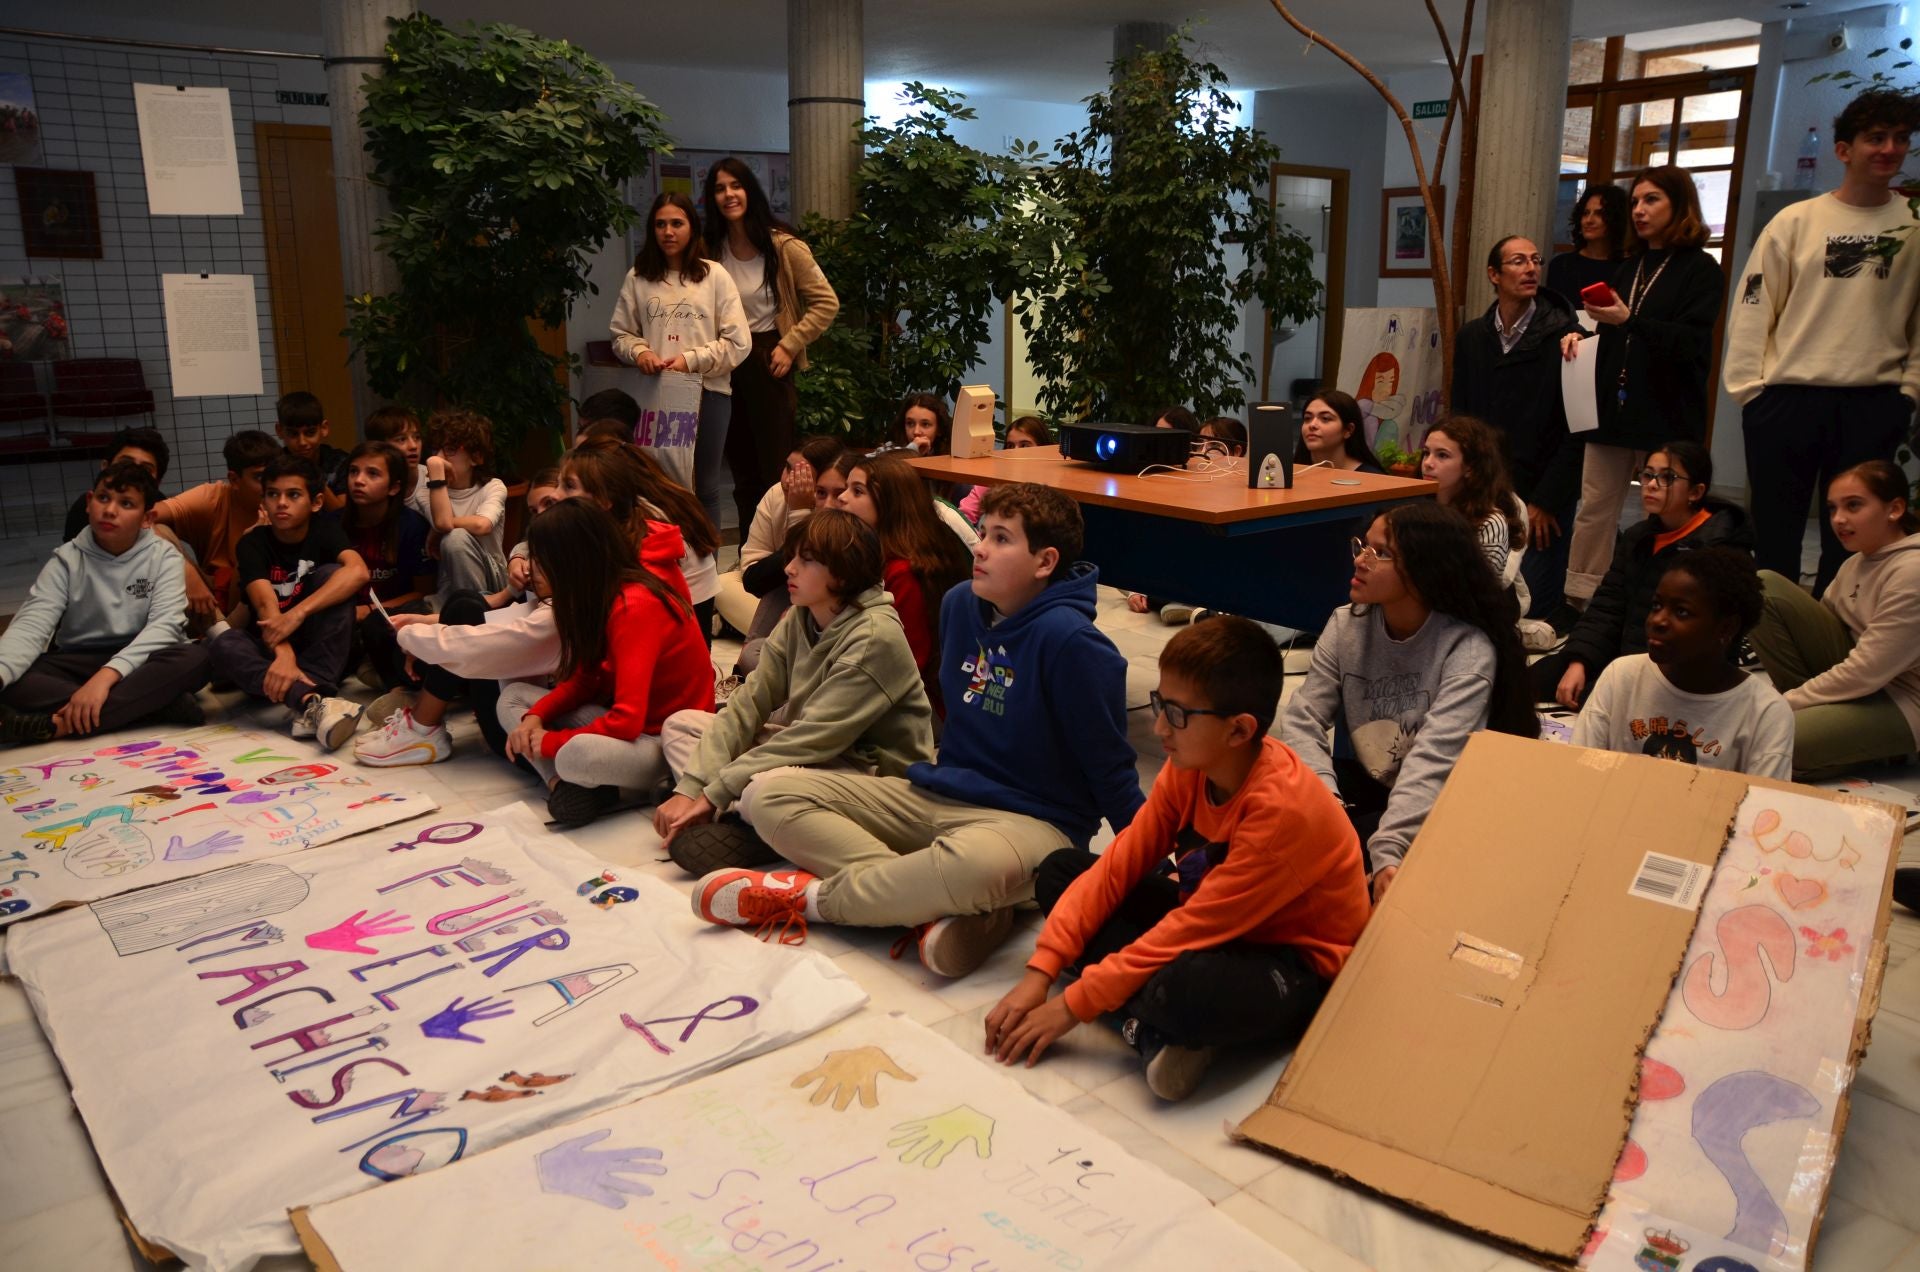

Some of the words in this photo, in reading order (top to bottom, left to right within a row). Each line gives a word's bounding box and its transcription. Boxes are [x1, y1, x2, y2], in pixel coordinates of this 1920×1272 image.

[1415, 103, 1447, 116] SALIDA
[646, 296, 708, 328] Ontario
[633, 408, 656, 447] UE
[982, 698, 1005, 716] BLU
[1629, 715, 1722, 758] 素晴らしい
[376, 857, 638, 1027] FUERA
[348, 944, 465, 1012] EL
[176, 920, 469, 1182] MACHISMO
[981, 1163, 1136, 1250] JUSTICIA
